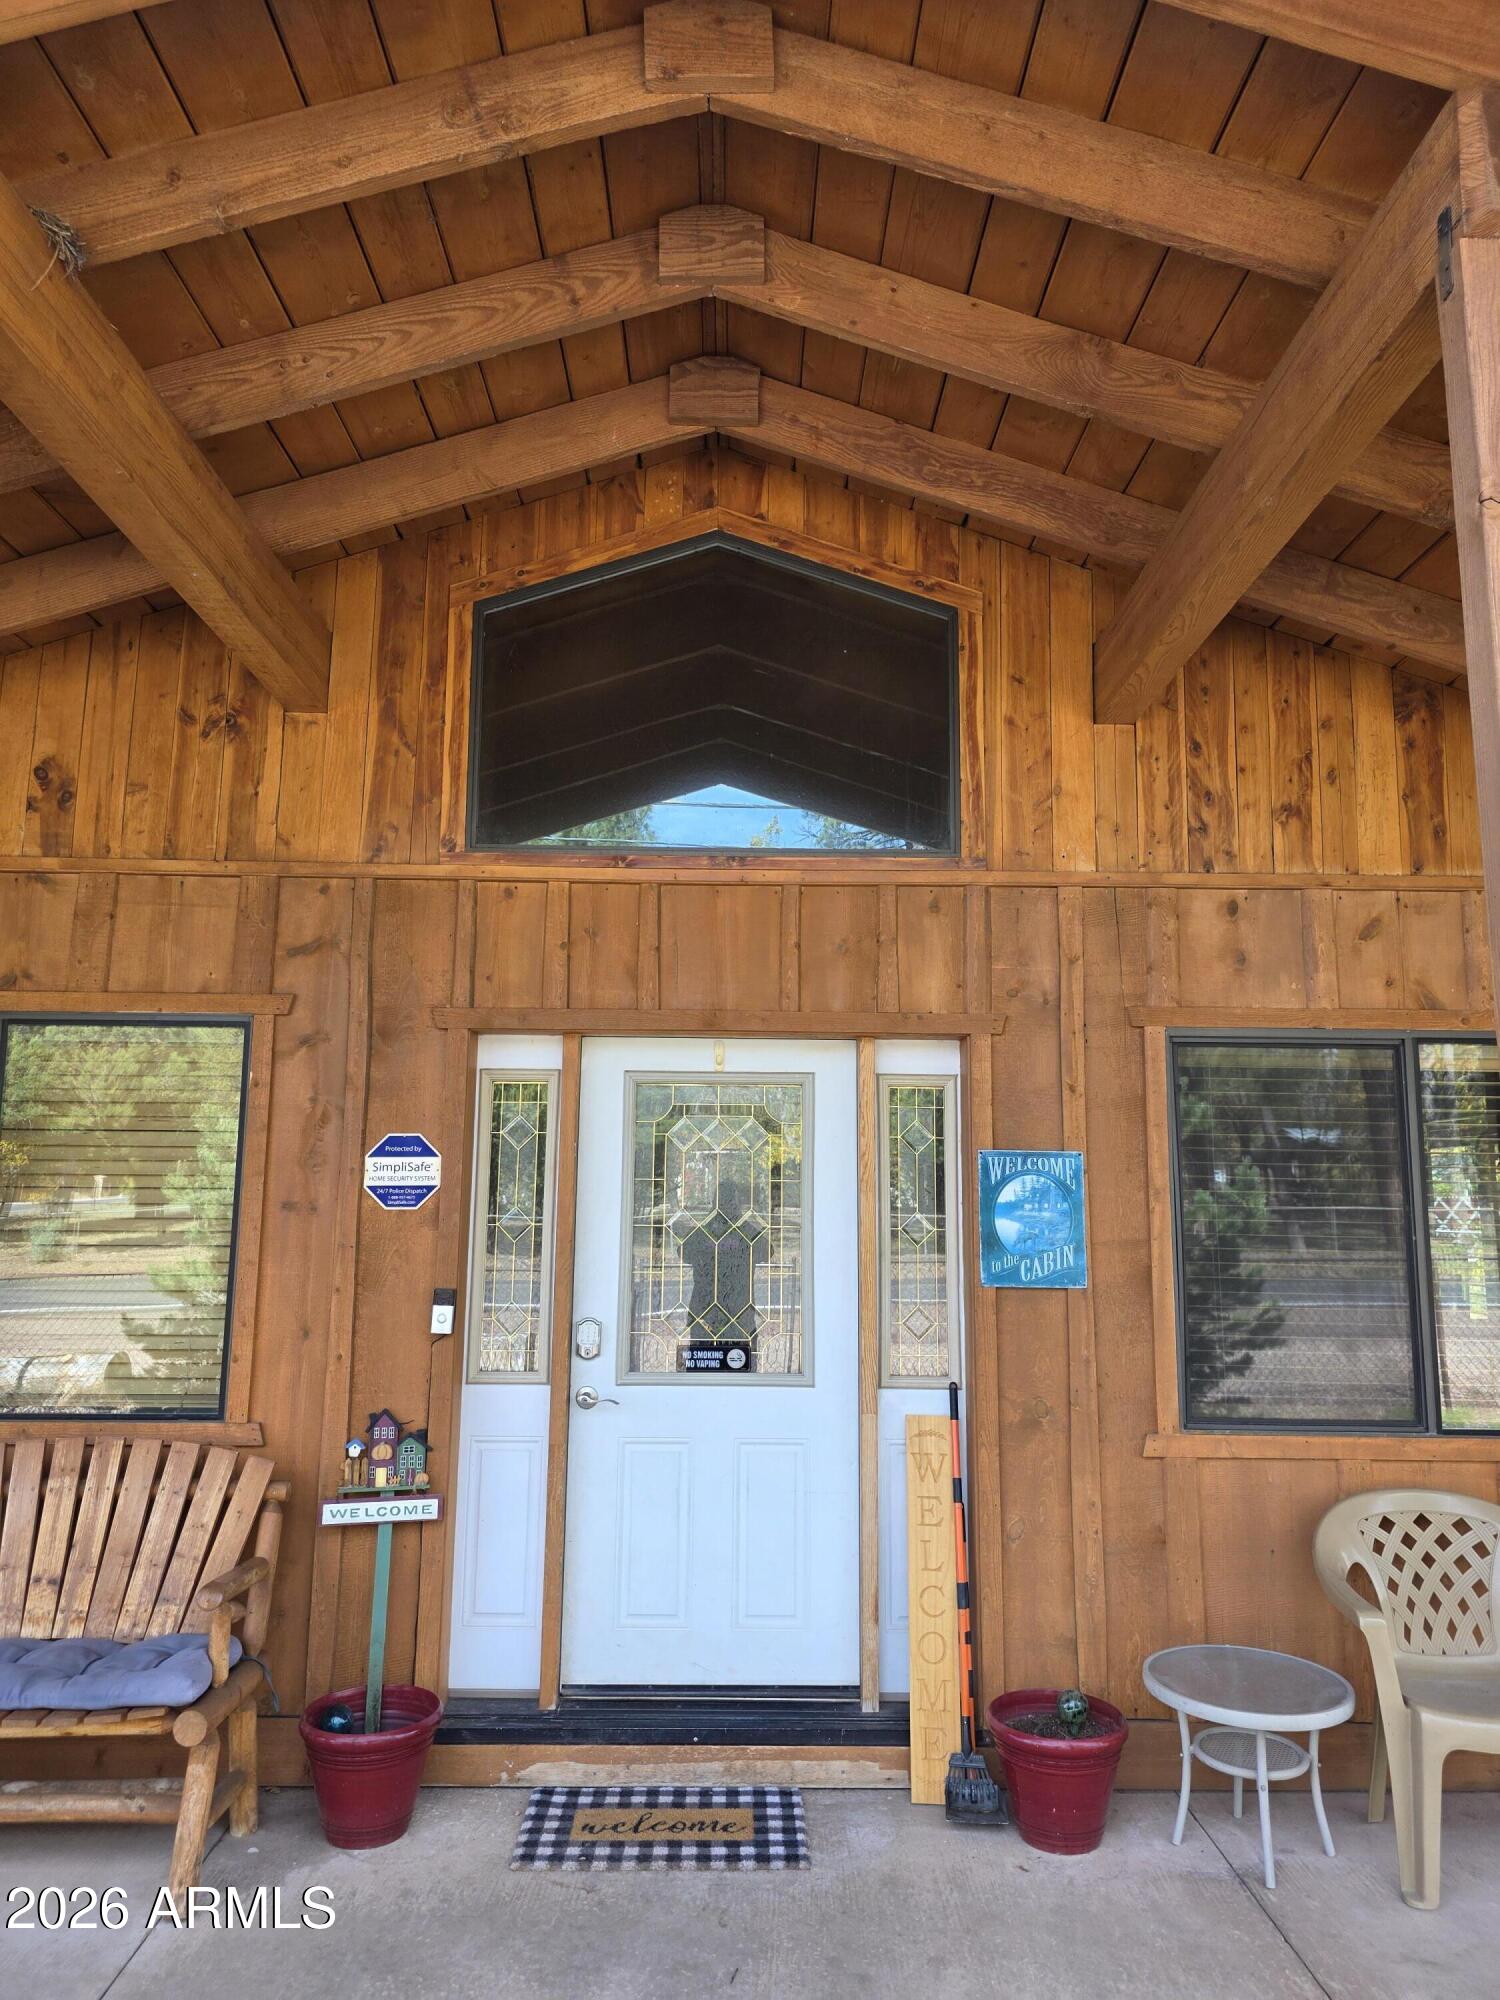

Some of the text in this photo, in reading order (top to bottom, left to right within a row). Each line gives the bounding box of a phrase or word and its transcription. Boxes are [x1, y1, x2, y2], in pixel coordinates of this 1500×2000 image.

[372, 1161, 431, 1174] SimpliSafe
[987, 1156, 1076, 1191] WELCOME
[992, 1245, 1074, 1282] to the CABIN
[682, 1350, 724, 1359] NO SMOKING
[685, 1359, 720, 1368] NO VAPING
[329, 1504, 433, 1519] WELCOME
[910, 1452, 951, 1761] WELCOME
[580, 1812, 746, 1835] welcome
